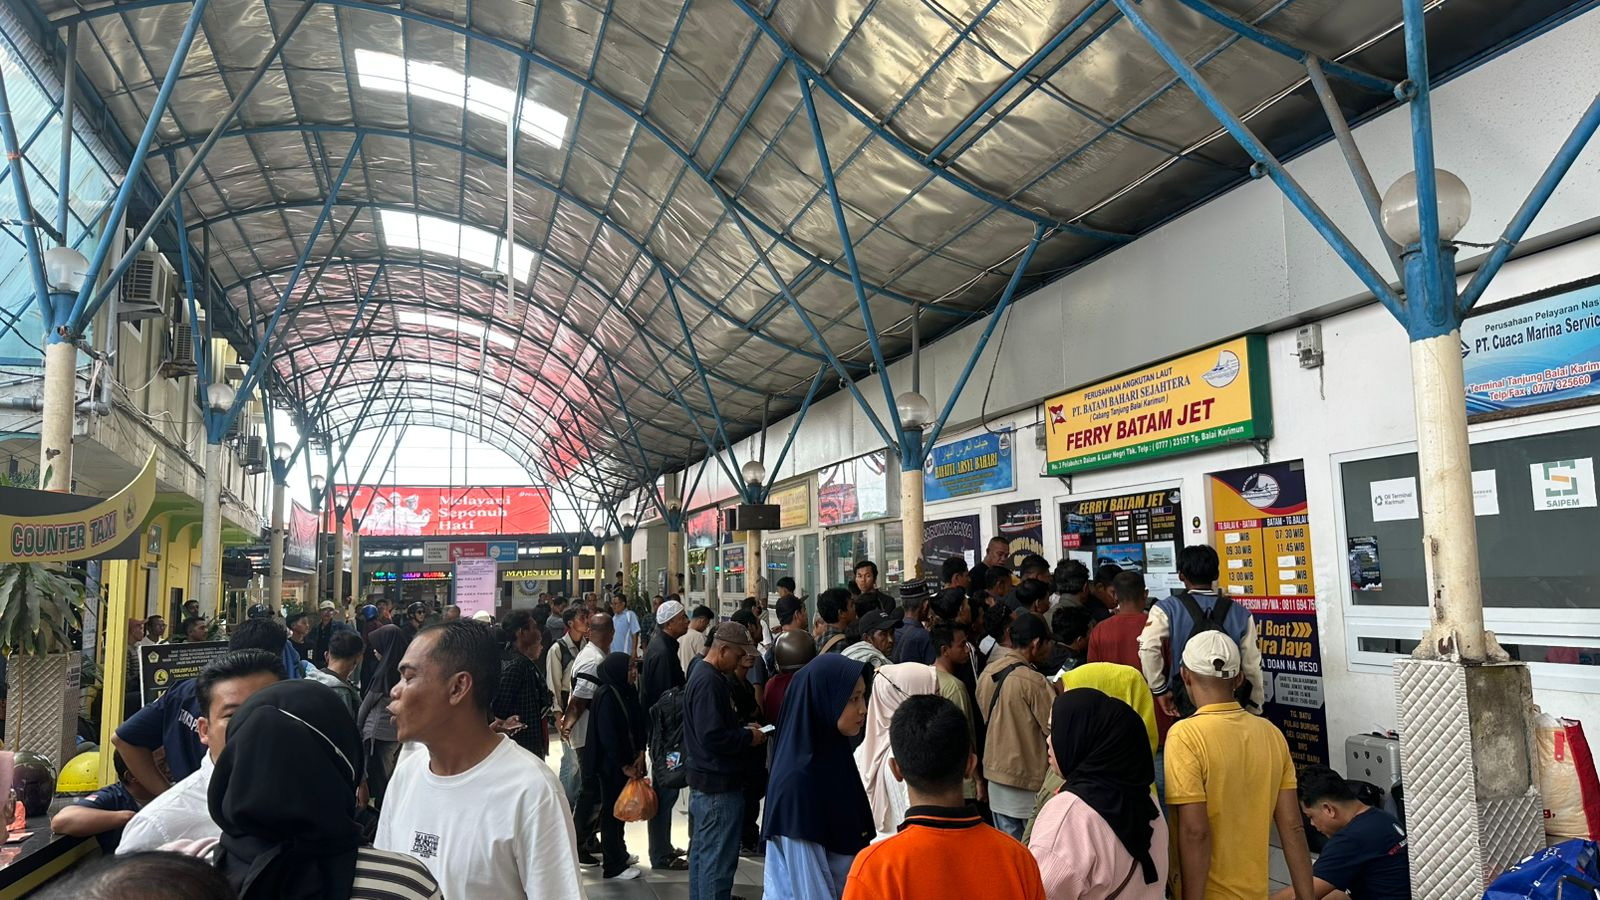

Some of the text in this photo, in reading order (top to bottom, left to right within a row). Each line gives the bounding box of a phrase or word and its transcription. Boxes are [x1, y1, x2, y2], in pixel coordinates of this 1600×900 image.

[1485, 297, 1600, 333] Perusahaan Pelayaran Nas
[1475, 312, 1600, 354] PT. Cuaca Marina Servic
[1084, 366, 1173, 400] PERUSAHAAN ANGKUTAN LAUT
[1469, 379, 1505, 393] Terminal
[1507, 373, 1543, 388] Tanjung
[1544, 366, 1569, 380] Balai
[1570, 360, 1600, 374] Karim
[1488, 387, 1525, 401] Telp/Fax
[1532, 380, 1554, 394] 0777
[1555, 374, 1591, 390] 325660
[1072, 375, 1191, 418] PT. BATAM BAHARI SEJAHTERA
[1092, 411, 1110, 421] Cabang
[1110, 405, 1129, 417] Tanjung
[1130, 401, 1143, 411] Balai
[1143, 394, 1166, 407] Karimun
[1066, 397, 1216, 452] FERRY BATAM JET
[1101, 452, 1112, 461] Luar
[1112, 448, 1126, 459] Negri
[1155, 439, 1169, 450] 0777
[1173, 435, 1190, 446] 23157
[1201, 429, 1217, 440] Balai
[1217, 425, 1244, 437] Karimun
[974, 452, 998, 470] BAHARI
[439, 495, 511, 507] Melayani
[1391, 491, 1412, 499] Terminal
[1078, 491, 1166, 515] FERRY BATAM JET
[1546, 498, 1580, 508] SAIPEM
[438, 506, 508, 520] Sepenuh
[439, 519, 475, 530] Hati
[1266, 517, 1283, 527] BATAM
[11, 509, 118, 556] COUNTER TAXI
[1240, 532, 1249, 541] WIB
[1293, 528, 1303, 538] WIB
[1242, 545, 1252, 555] WIB
[1294, 542, 1305, 552] WIB
[1243, 558, 1252, 568] WIB
[1296, 555, 1306, 566] WIB
[506, 569, 557, 578] MAJESTIC
[1244, 571, 1253, 581] WIB
[1296, 569, 1307, 580] WIB
[1244, 584, 1253, 594] WIB
[1297, 583, 1308, 594] WIB
[1243, 599, 1260, 610] PERSON
[1282, 599, 1295, 611] 0811
[1295, 600, 1307, 611] 694
[1307, 600, 1315, 612] 75
[1265, 619, 1291, 637] Boat
[1279, 637, 1312, 659] Jaya
[1267, 658, 1286, 670] DOAN
[1286, 660, 1297, 671] NA
[1298, 661, 1318, 673] RESO
